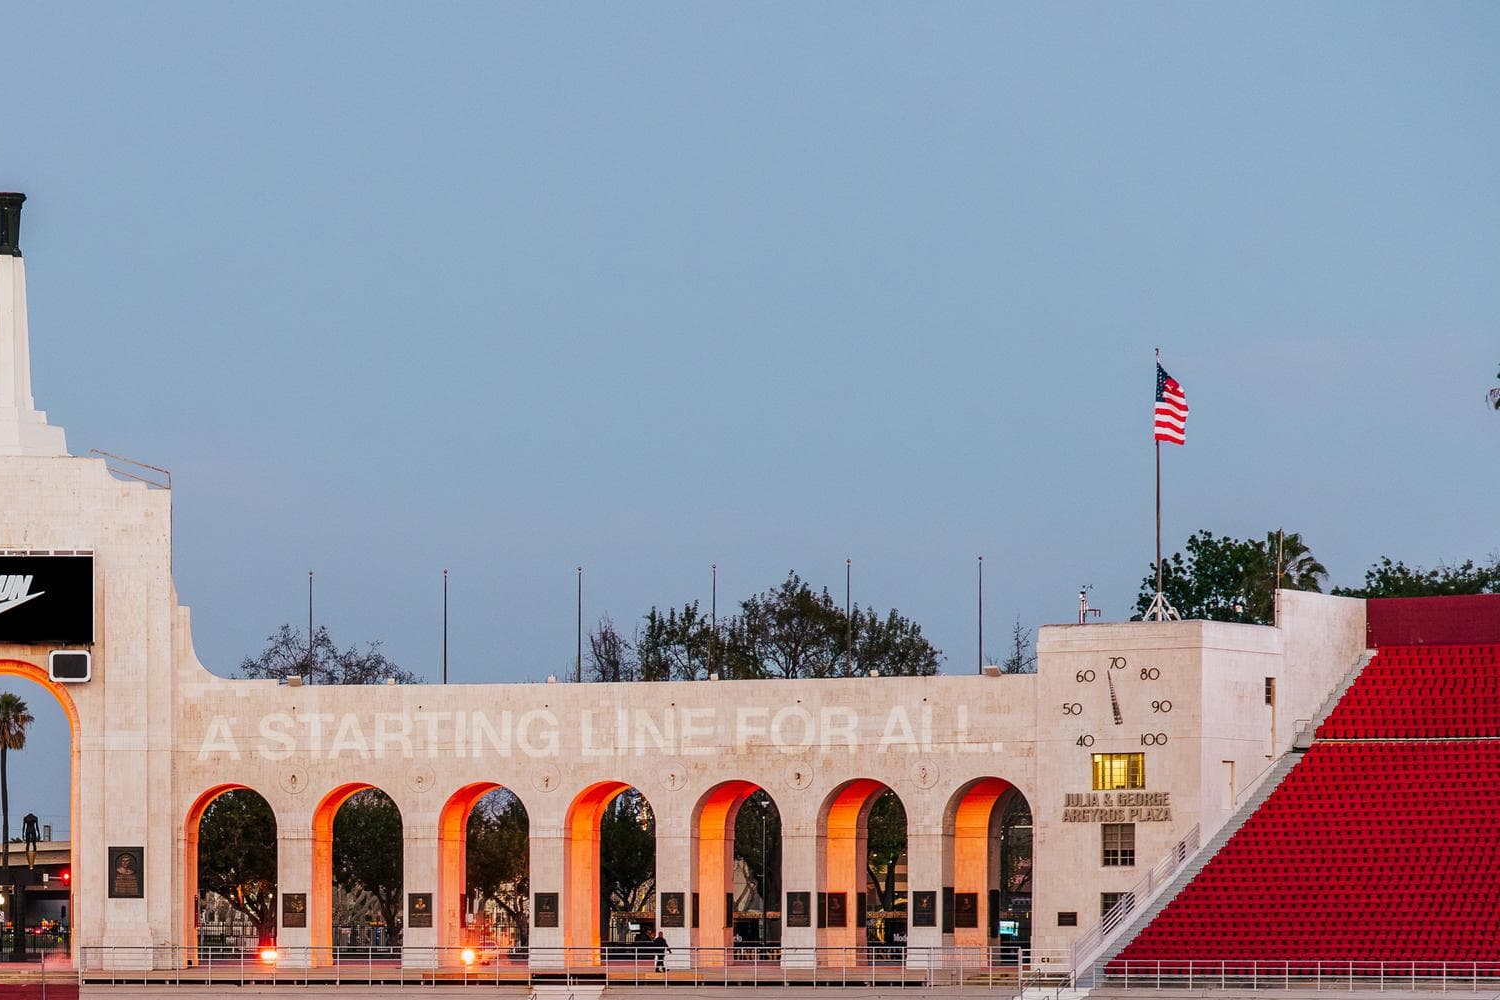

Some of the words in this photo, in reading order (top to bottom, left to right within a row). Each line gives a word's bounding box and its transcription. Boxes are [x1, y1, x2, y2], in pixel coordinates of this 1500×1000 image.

[1108, 656, 1127, 669] 70
[1076, 669, 1096, 682] 60
[1140, 667, 1160, 680] 80
[1062, 702, 1083, 715] 50
[1151, 700, 1172, 713] 90
[197, 714, 242, 761] A
[257, 708, 561, 761] STARTING
[580, 706, 718, 757] LINE
[735, 704, 861, 755] FOR
[877, 703, 1003, 754] ALL.
[1076, 734, 1095, 747] 40
[1140, 732, 1168, 746] 100
[1063, 792, 1100, 808] JULIA
[1102, 792, 1114, 807] &
[1116, 792, 1171, 807] GEORGE
[1062, 808, 1126, 823] ARGYROS
[1128, 807, 1173, 822] PLAZA
